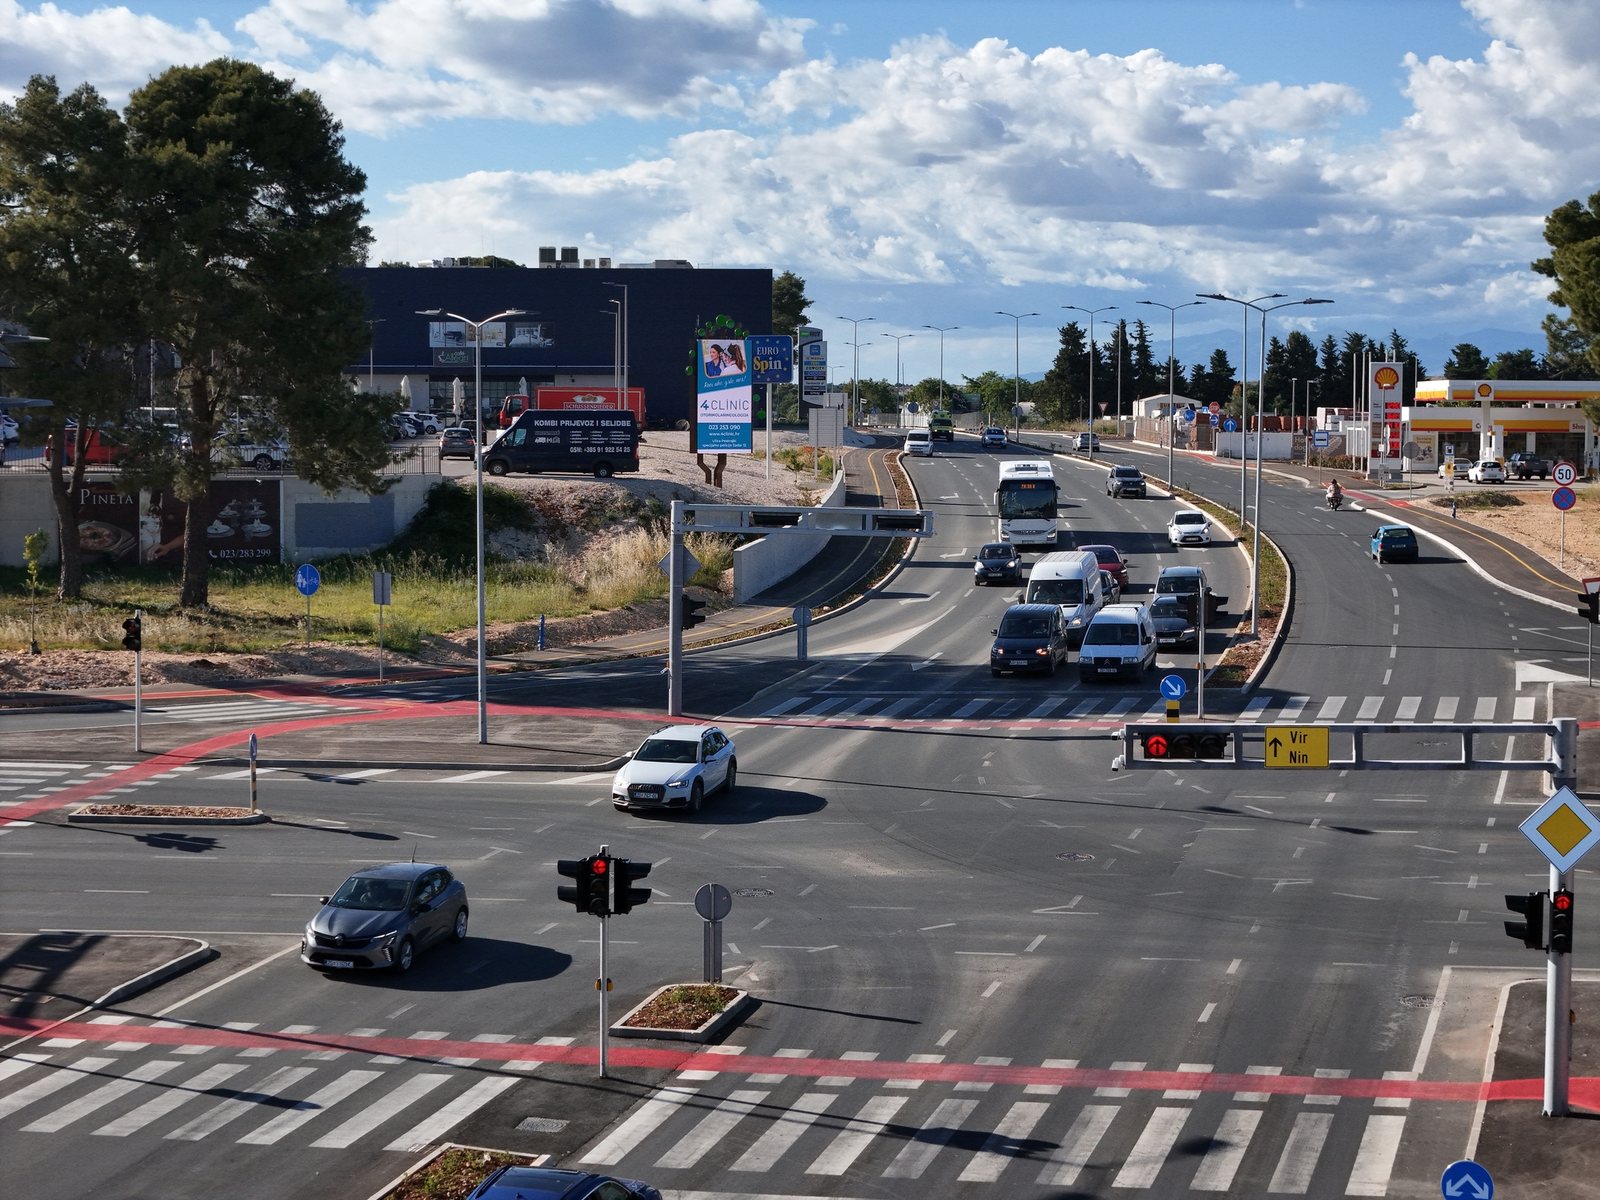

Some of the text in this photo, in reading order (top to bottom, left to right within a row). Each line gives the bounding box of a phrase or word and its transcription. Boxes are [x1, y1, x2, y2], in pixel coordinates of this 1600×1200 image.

[757, 347, 779, 355] EURO
[753, 356, 782, 374] Spin
[1557, 468, 1572, 480] 50
[80, 488, 134, 505] PINETA
[219, 548, 271, 558] 023/283 299
[1290, 731, 1308, 744] Vir
[1289, 751, 1308, 764] Nin
